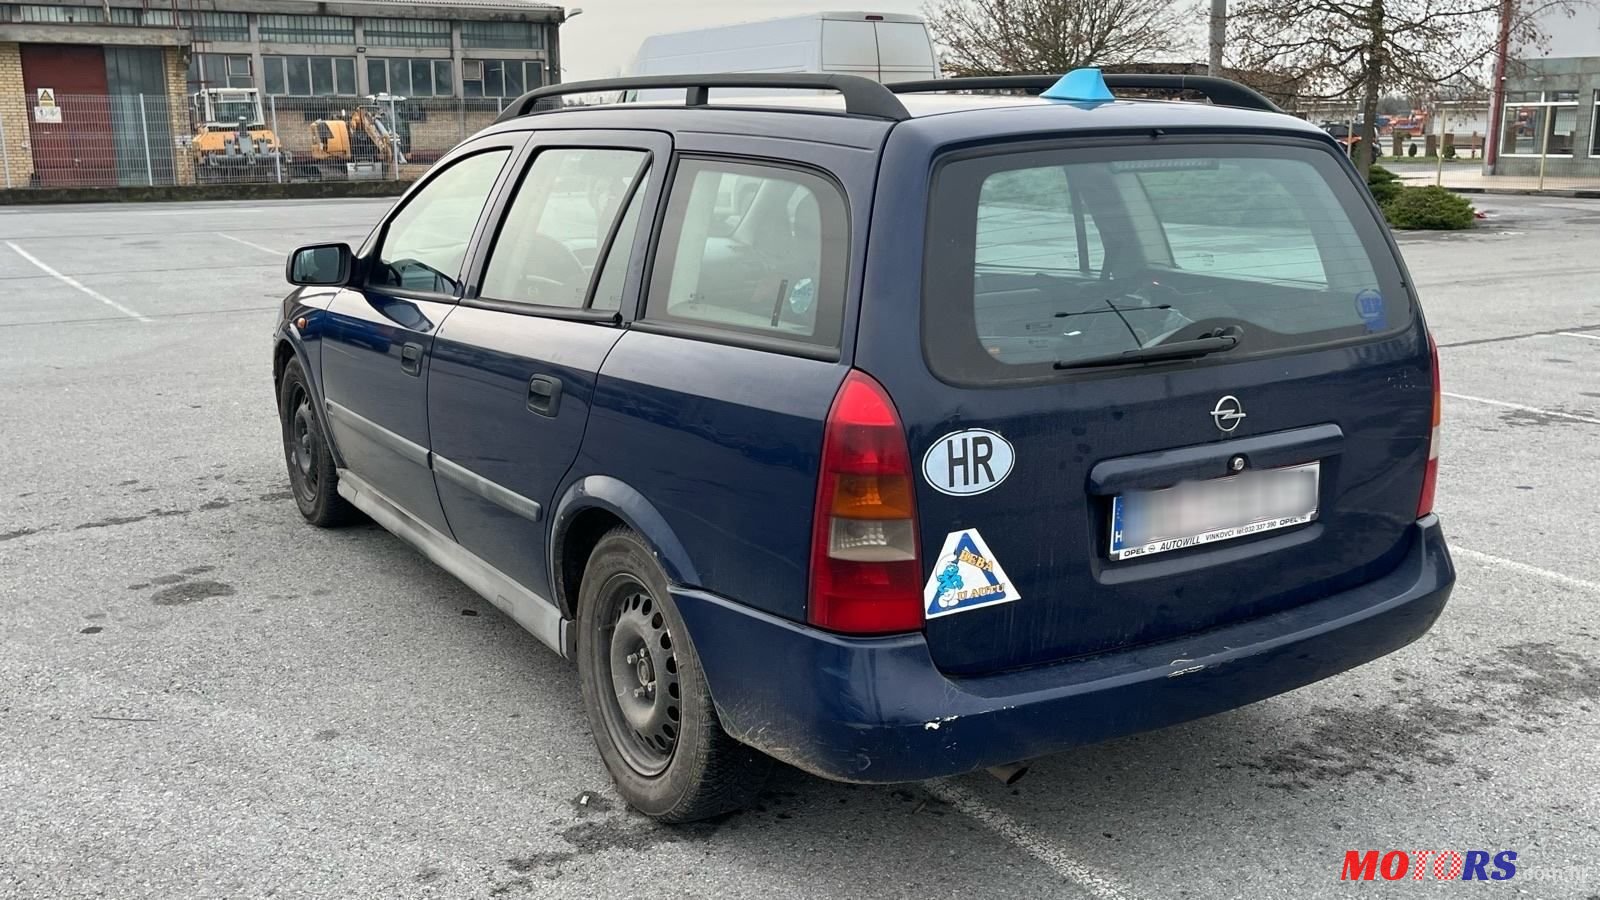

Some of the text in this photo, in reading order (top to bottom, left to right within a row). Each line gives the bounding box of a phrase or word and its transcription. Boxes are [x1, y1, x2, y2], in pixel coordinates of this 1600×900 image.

[947, 436, 995, 488] HR
[1124, 547, 1145, 557] OPEL
[1160, 535, 1200, 551] AUTOWILL
[1205, 529, 1234, 541] VINKOVCI
[1279, 517, 1298, 526] OPEL
[958, 549, 994, 572] BEBA
[970, 582, 1005, 598] AUTU
